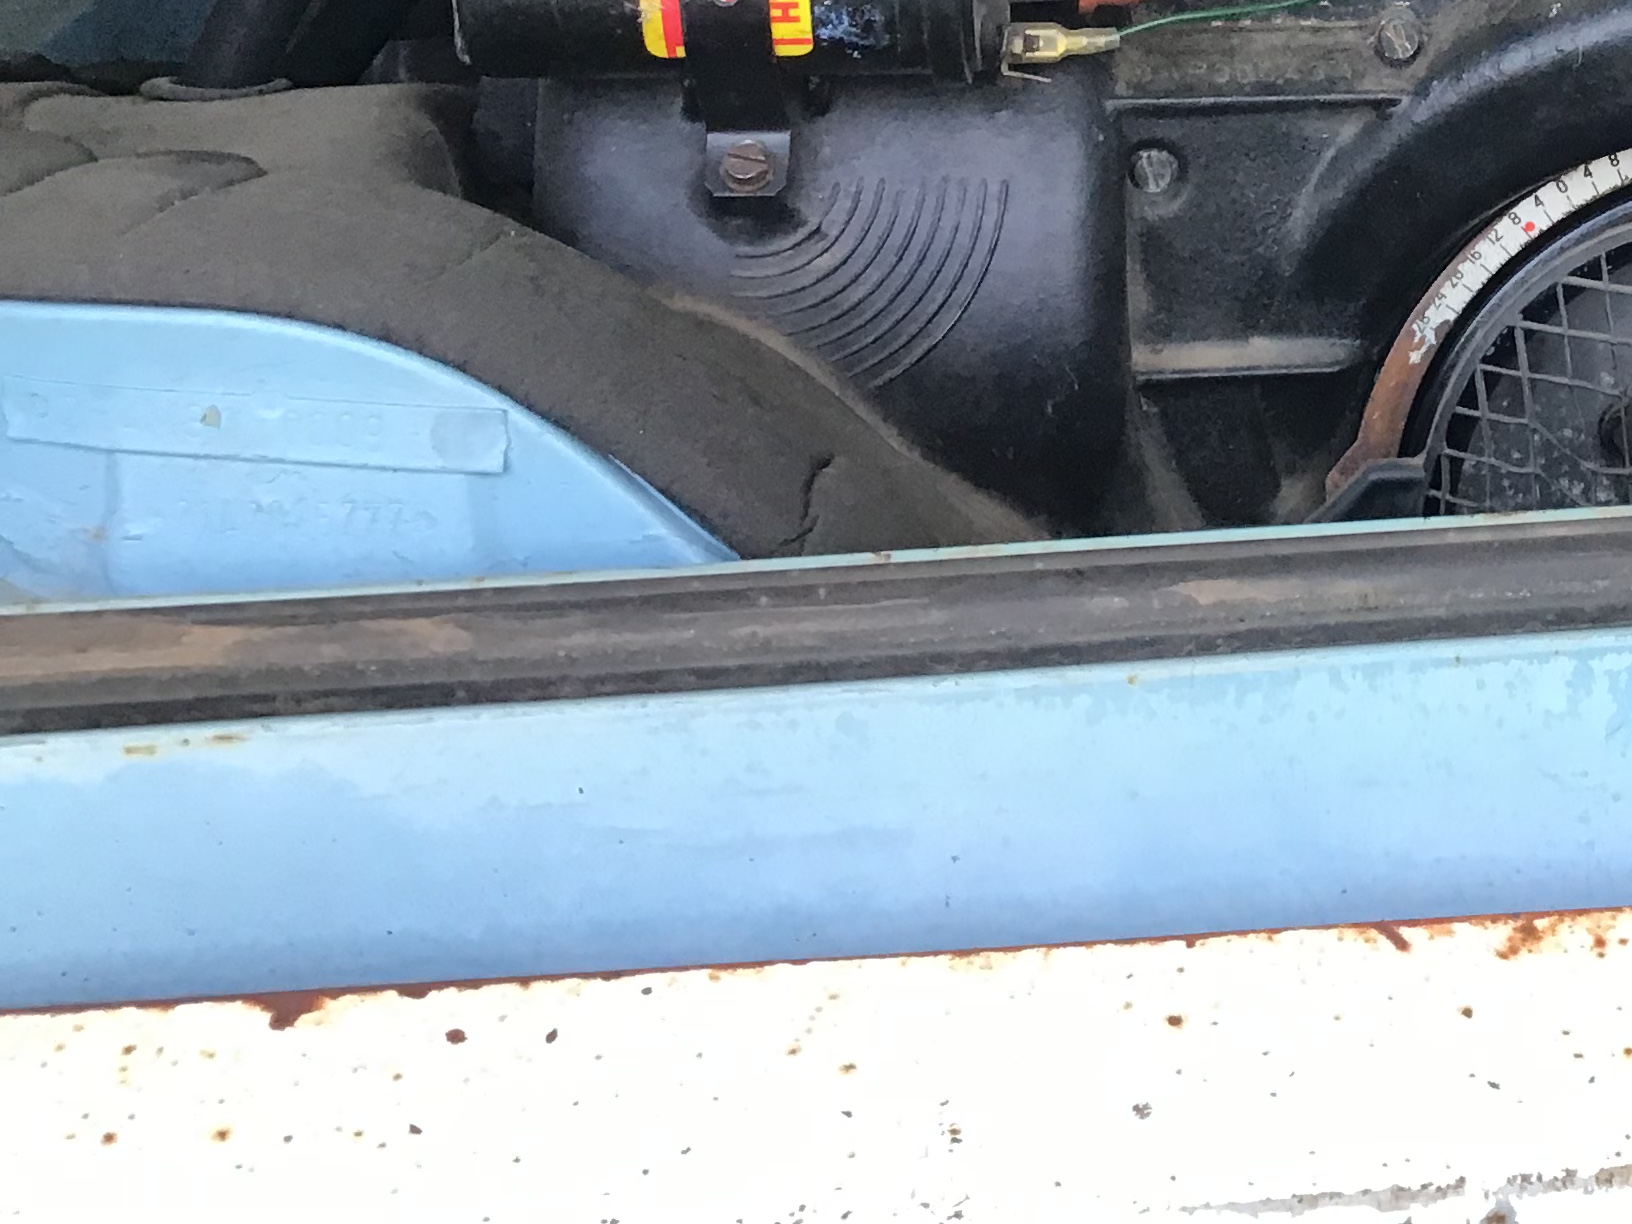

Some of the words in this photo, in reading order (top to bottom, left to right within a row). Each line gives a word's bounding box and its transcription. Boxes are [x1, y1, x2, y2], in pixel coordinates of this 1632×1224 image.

[1449, 271, 1464, 288] 20
[1468, 251, 1482, 264] 16
[1487, 229, 1504, 245] 12
[1508, 212, 1521, 225] 8
[1534, 195, 1544, 208] 4
[1556, 180, 1568, 193] 0
[1583, 165, 1593, 179] 4
[1608, 153, 1620, 167] 8
